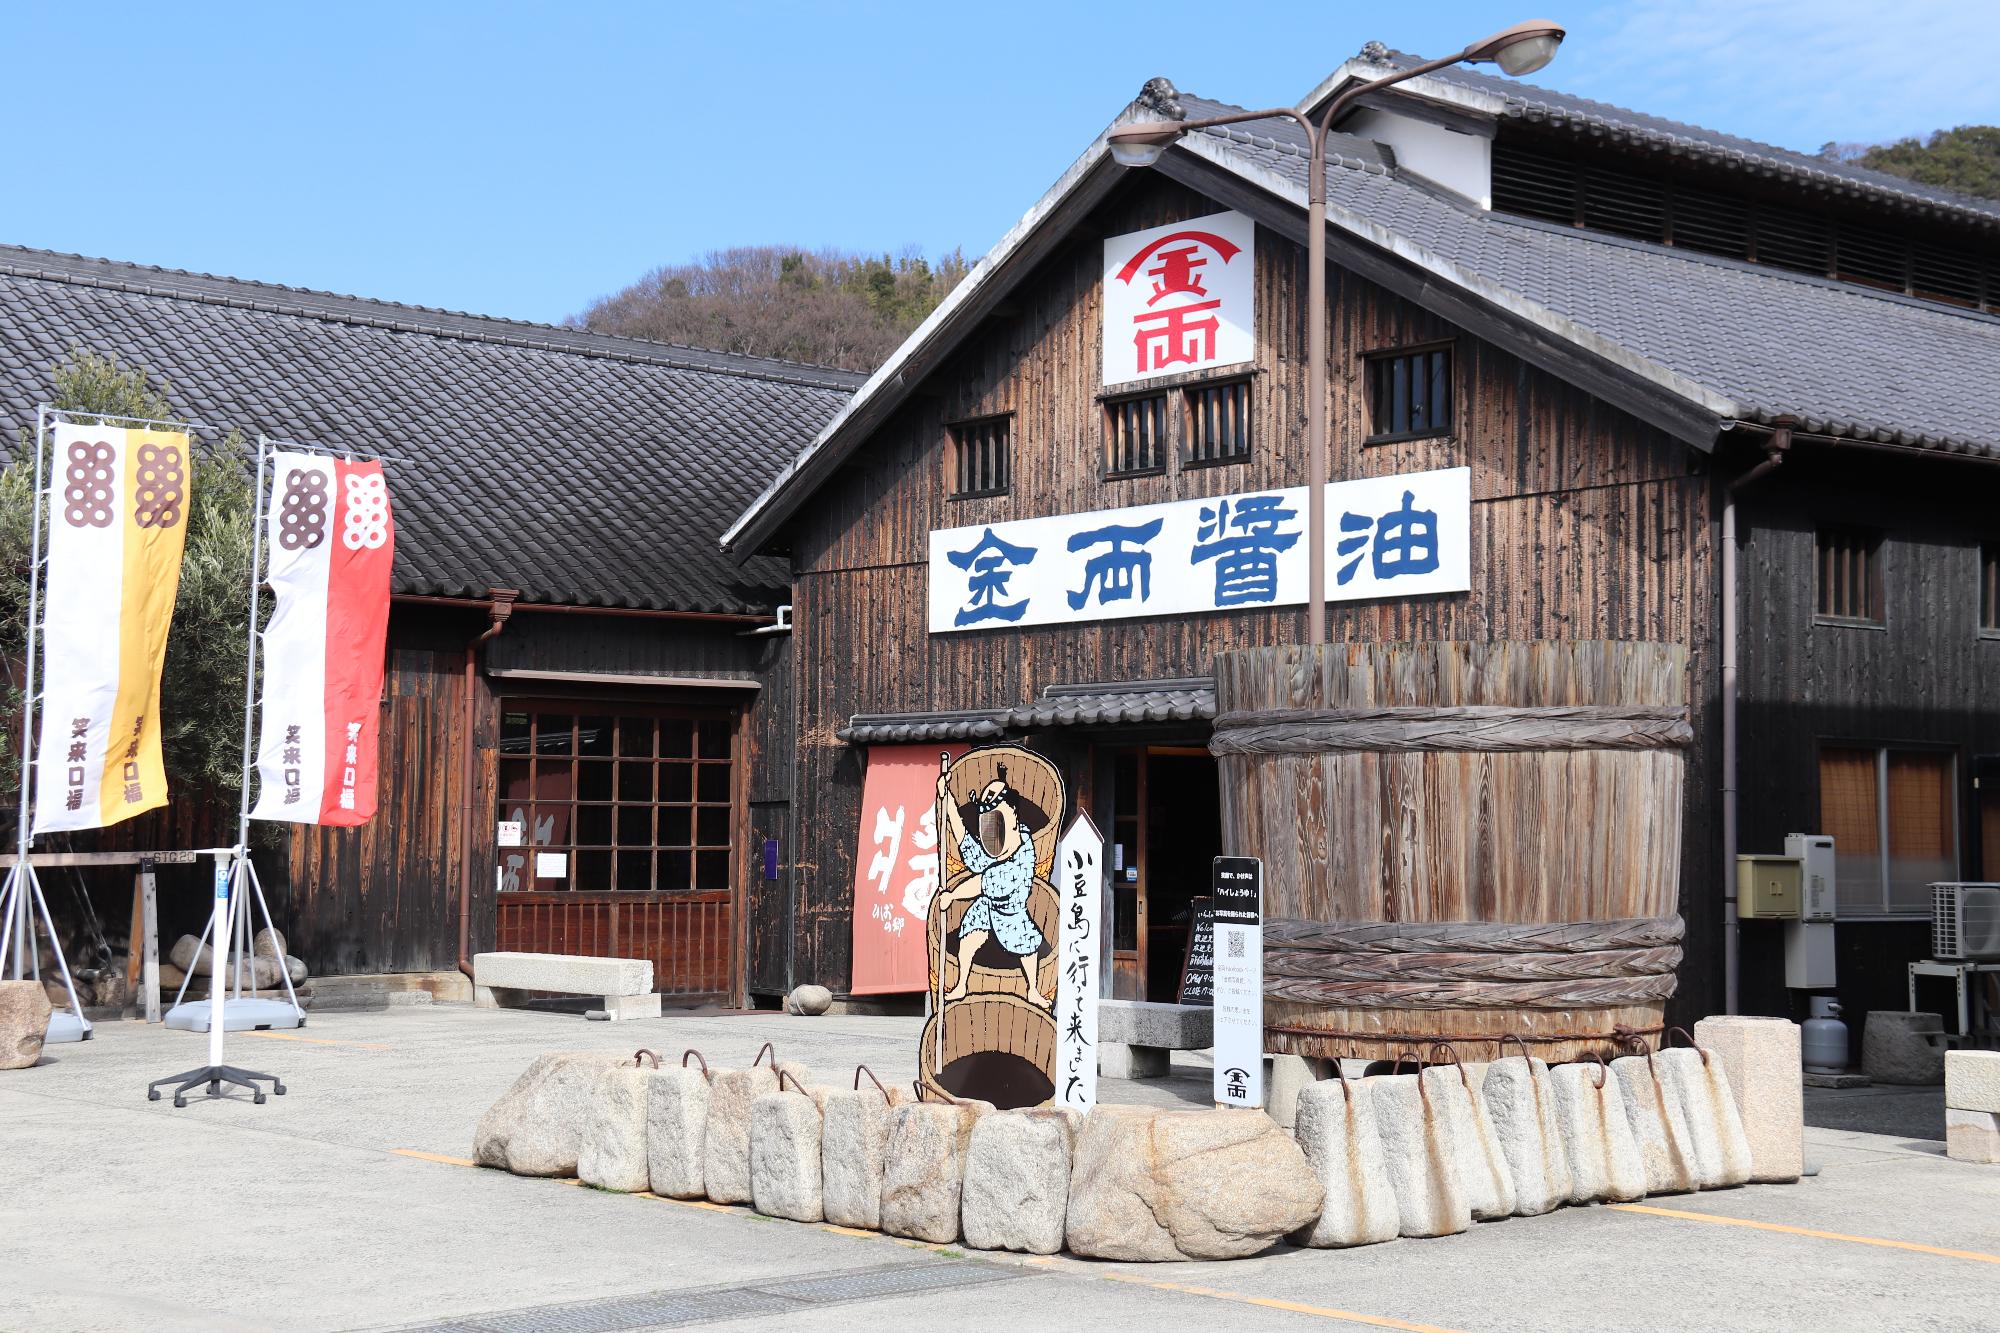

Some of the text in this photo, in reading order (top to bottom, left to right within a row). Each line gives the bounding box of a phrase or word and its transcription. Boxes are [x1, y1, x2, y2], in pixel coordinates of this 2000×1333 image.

[1115, 231, 1242, 373] 金両
[946, 490, 1440, 627] 金両醤油
[66, 717, 91, 812] 笑来口福
[283, 724, 301, 805] 笑来口福
[339, 721, 362, 810] 笑来口福
[1064, 849, 1092, 1103] 小豆島に行って来ました
